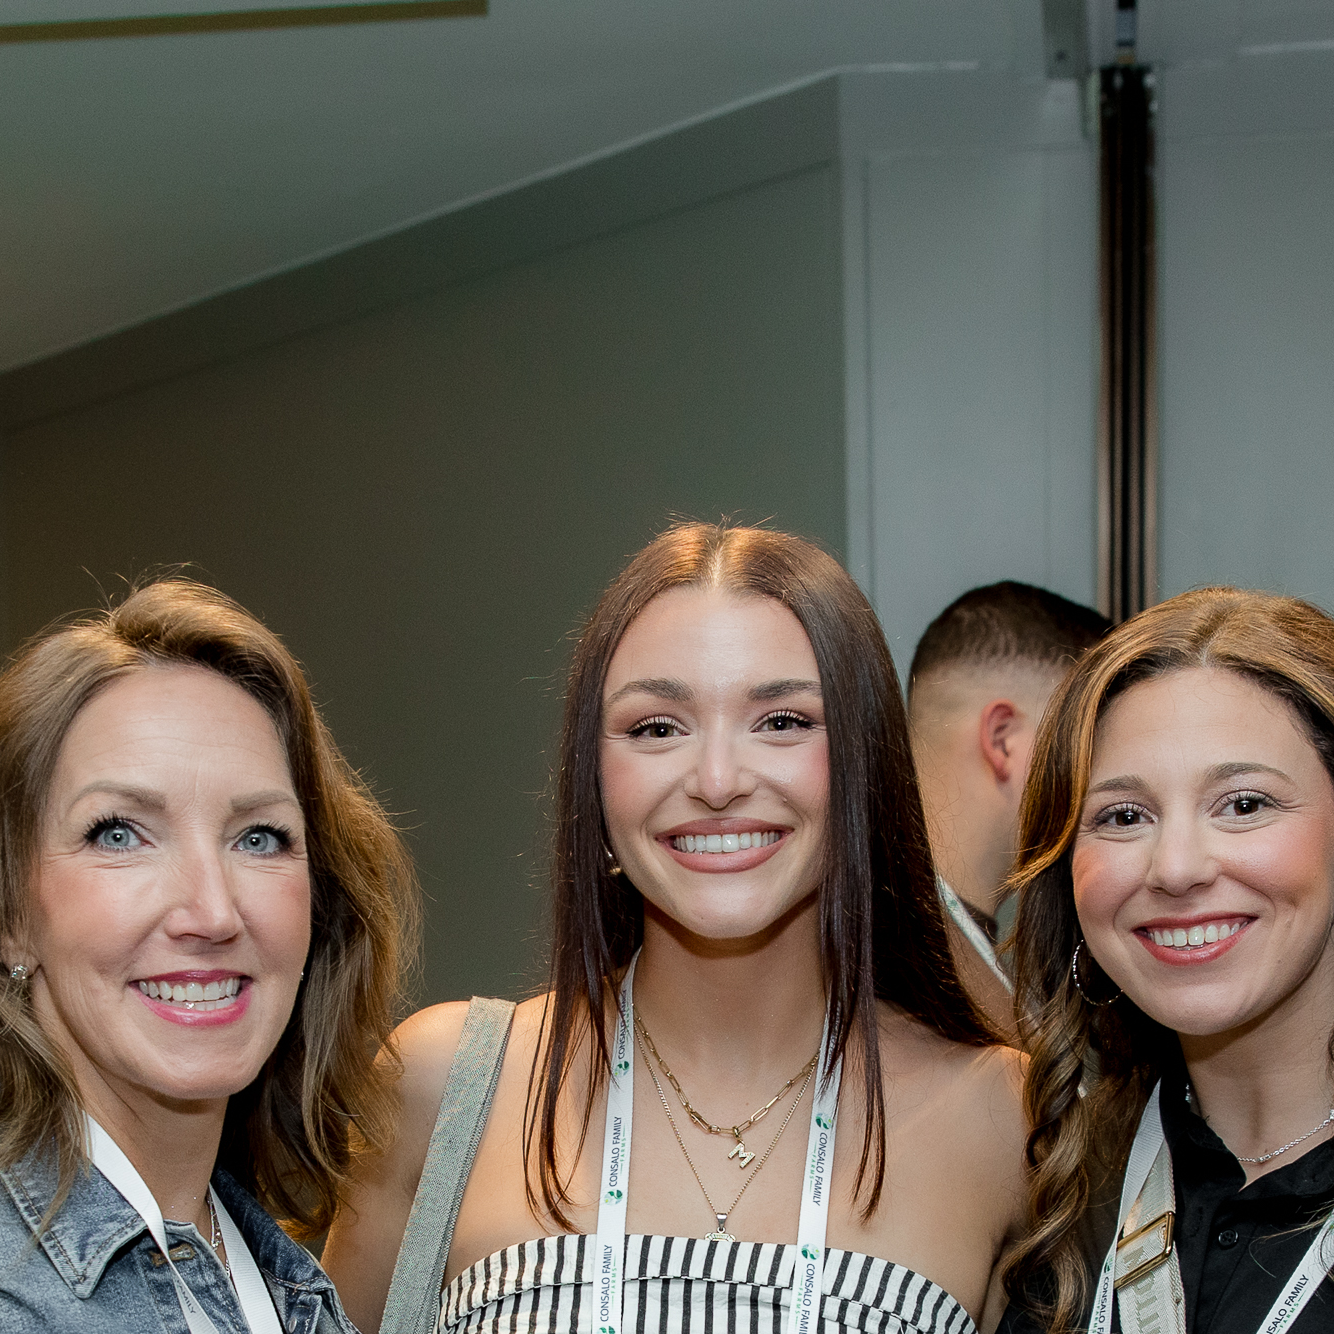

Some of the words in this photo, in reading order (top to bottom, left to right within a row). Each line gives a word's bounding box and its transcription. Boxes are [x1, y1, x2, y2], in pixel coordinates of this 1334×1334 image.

[612, 1116, 623, 1151] FAMILY
[609, 1151, 621, 1188] CONSALO
[808, 1154, 816, 1179] FARMS
[815, 1132, 828, 1174] CONSALO
[812, 1175, 824, 1207] FAMILY
[602, 1244, 613, 1276] FAMILY
[601, 1277, 611, 1322] CONSALO
[795, 1287, 803, 1315] FARMS
[802, 1263, 815, 1307] CONSALO
[1098, 1276, 1110, 1324] CONSALO
[1284, 1274, 1310, 1308] FAMILY
[1279, 1302, 1300, 1328] FARMS
